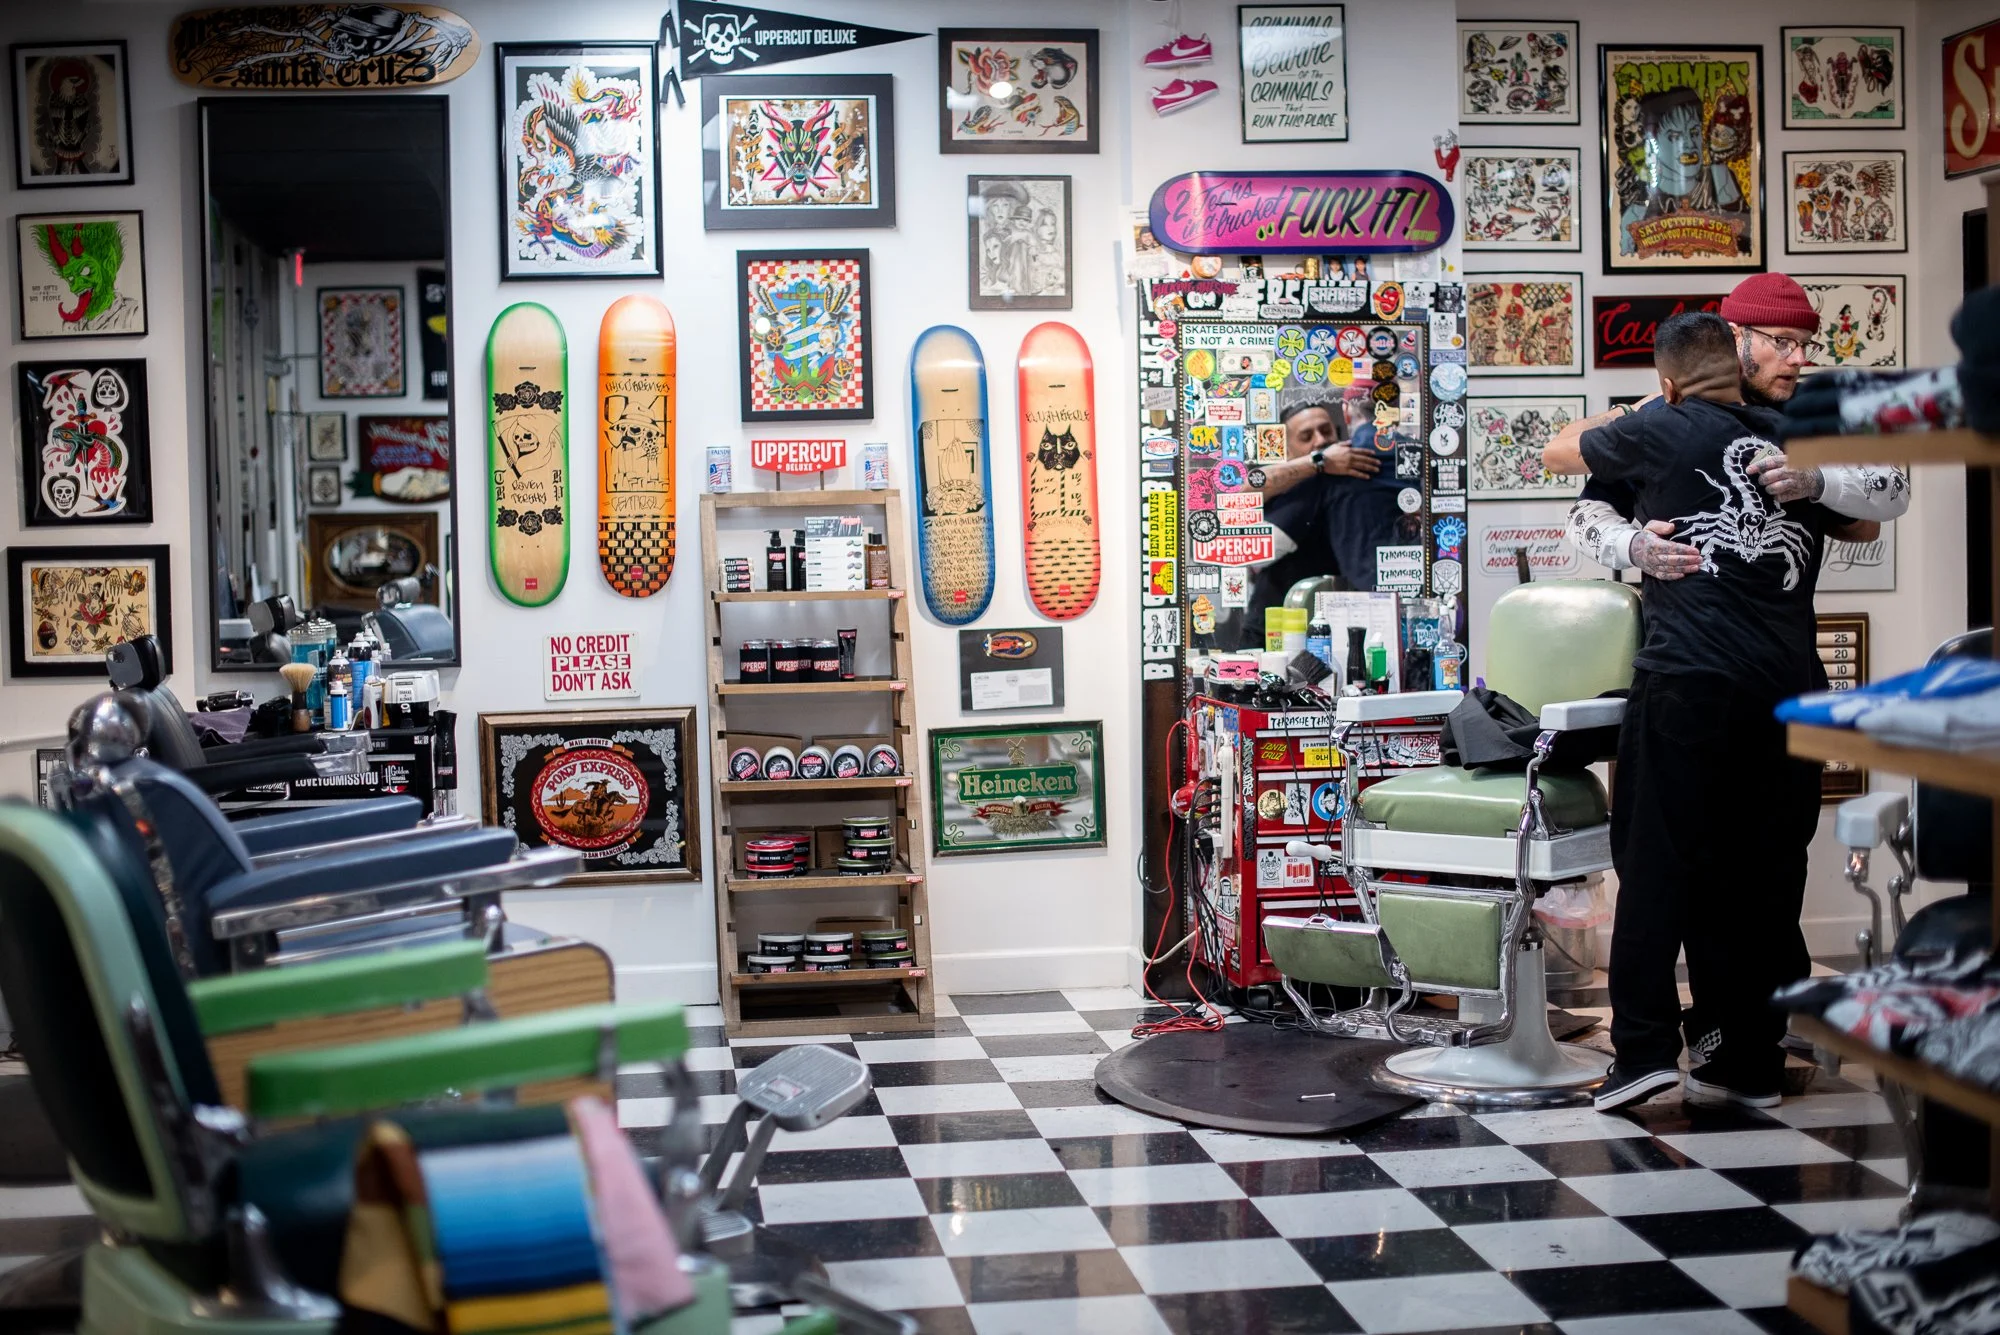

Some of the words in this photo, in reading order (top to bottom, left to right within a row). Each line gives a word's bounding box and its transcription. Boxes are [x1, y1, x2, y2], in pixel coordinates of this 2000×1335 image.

[754, 29, 812, 46] UPPERCUT
[815, 28, 857, 45] DELUXE
[1615, 61, 1749, 103] CRAMPS
[1251, 81, 1333, 102] CRIMINALS
[1252, 114, 1277, 128] RUN
[1278, 114, 1304, 128] THIS
[1304, 113, 1338, 127] PLACE
[1174, 190, 1190, 223] 2
[1193, 180, 1258, 216] Tears
[1278, 186, 1372, 239] FUCK
[1369, 186, 1430, 239] IT!
[1638, 222, 1658, 238] SAT
[1660, 217, 1706, 229] OCTOBER
[1641, 228, 1681, 247] HOLLYWOOD
[1681, 227, 1715, 241] ATHLETIC
[1714, 233, 1732, 246] CLUB
[1185, 325, 1275, 334] SKATEBOARDING
[1185, 337, 1194, 345] IS
[1200, 337, 1222, 345] NOT
[1227, 337, 1235, 345] A
[1240, 337, 1275, 345] CRIME
[754, 442, 844, 467] UPPERCUT
[785, 463, 813, 471] DELUXE
[1219, 494, 1262, 508] UPPERCUT
[1150, 493, 1160, 530] DAVIS
[1219, 511, 1262, 525] UPPERCUT
[1165, 492, 1175, 558] PRESIDENT
[1244, 526, 1270, 534] DEALER
[1150, 534, 1160, 558] BEN
[1197, 538, 1272, 559] UPPERCUT
[1379, 551, 1422, 563] THRASHER
[1380, 569, 1423, 582] THRASHER
[550, 636, 572, 654] NO
[576, 634, 629, 653] CREDIT
[1834, 633, 1848, 643] 25
[1834, 650, 1848, 659] 20
[555, 654, 630, 672] PLEASE
[741, 661, 767, 670] UPPERCUT
[1836, 666, 1848, 675] 10
[552, 673, 597, 692] DON'T
[601, 672, 631, 690] ASK
[1271, 715, 1309, 729] THRASHE
[586, 739, 609, 747] AGENTS
[1262, 742, 1287, 752] SANTA
[1261, 752, 1283, 761] CRUZ
[546, 763, 577, 791] PONY
[580, 761, 634, 790] EXPRESS
[963, 771, 1072, 797] Heineken
[600, 844, 629, 857] FRANCISCO
